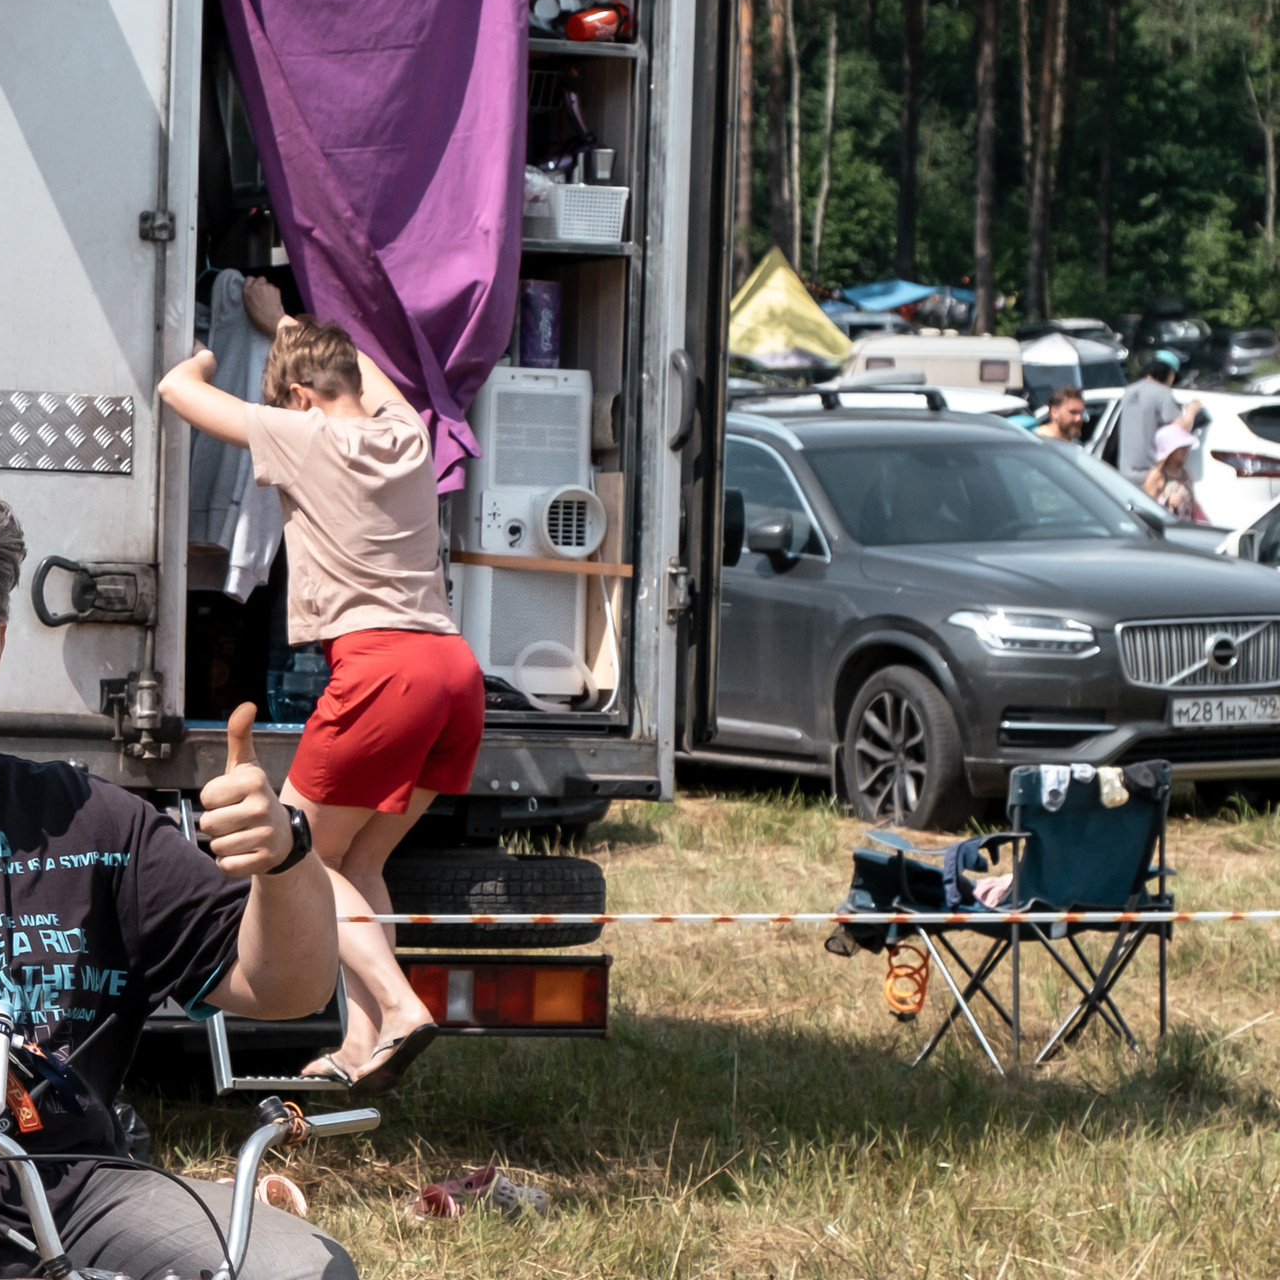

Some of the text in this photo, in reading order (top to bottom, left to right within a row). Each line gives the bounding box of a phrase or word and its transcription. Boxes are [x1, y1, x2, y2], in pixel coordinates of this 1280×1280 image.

[1176, 696, 1276, 722] М281НХ 799
[45, 857, 56, 871] A
[20, 913, 61, 927] WAVE
[12, 931, 33, 957] A
